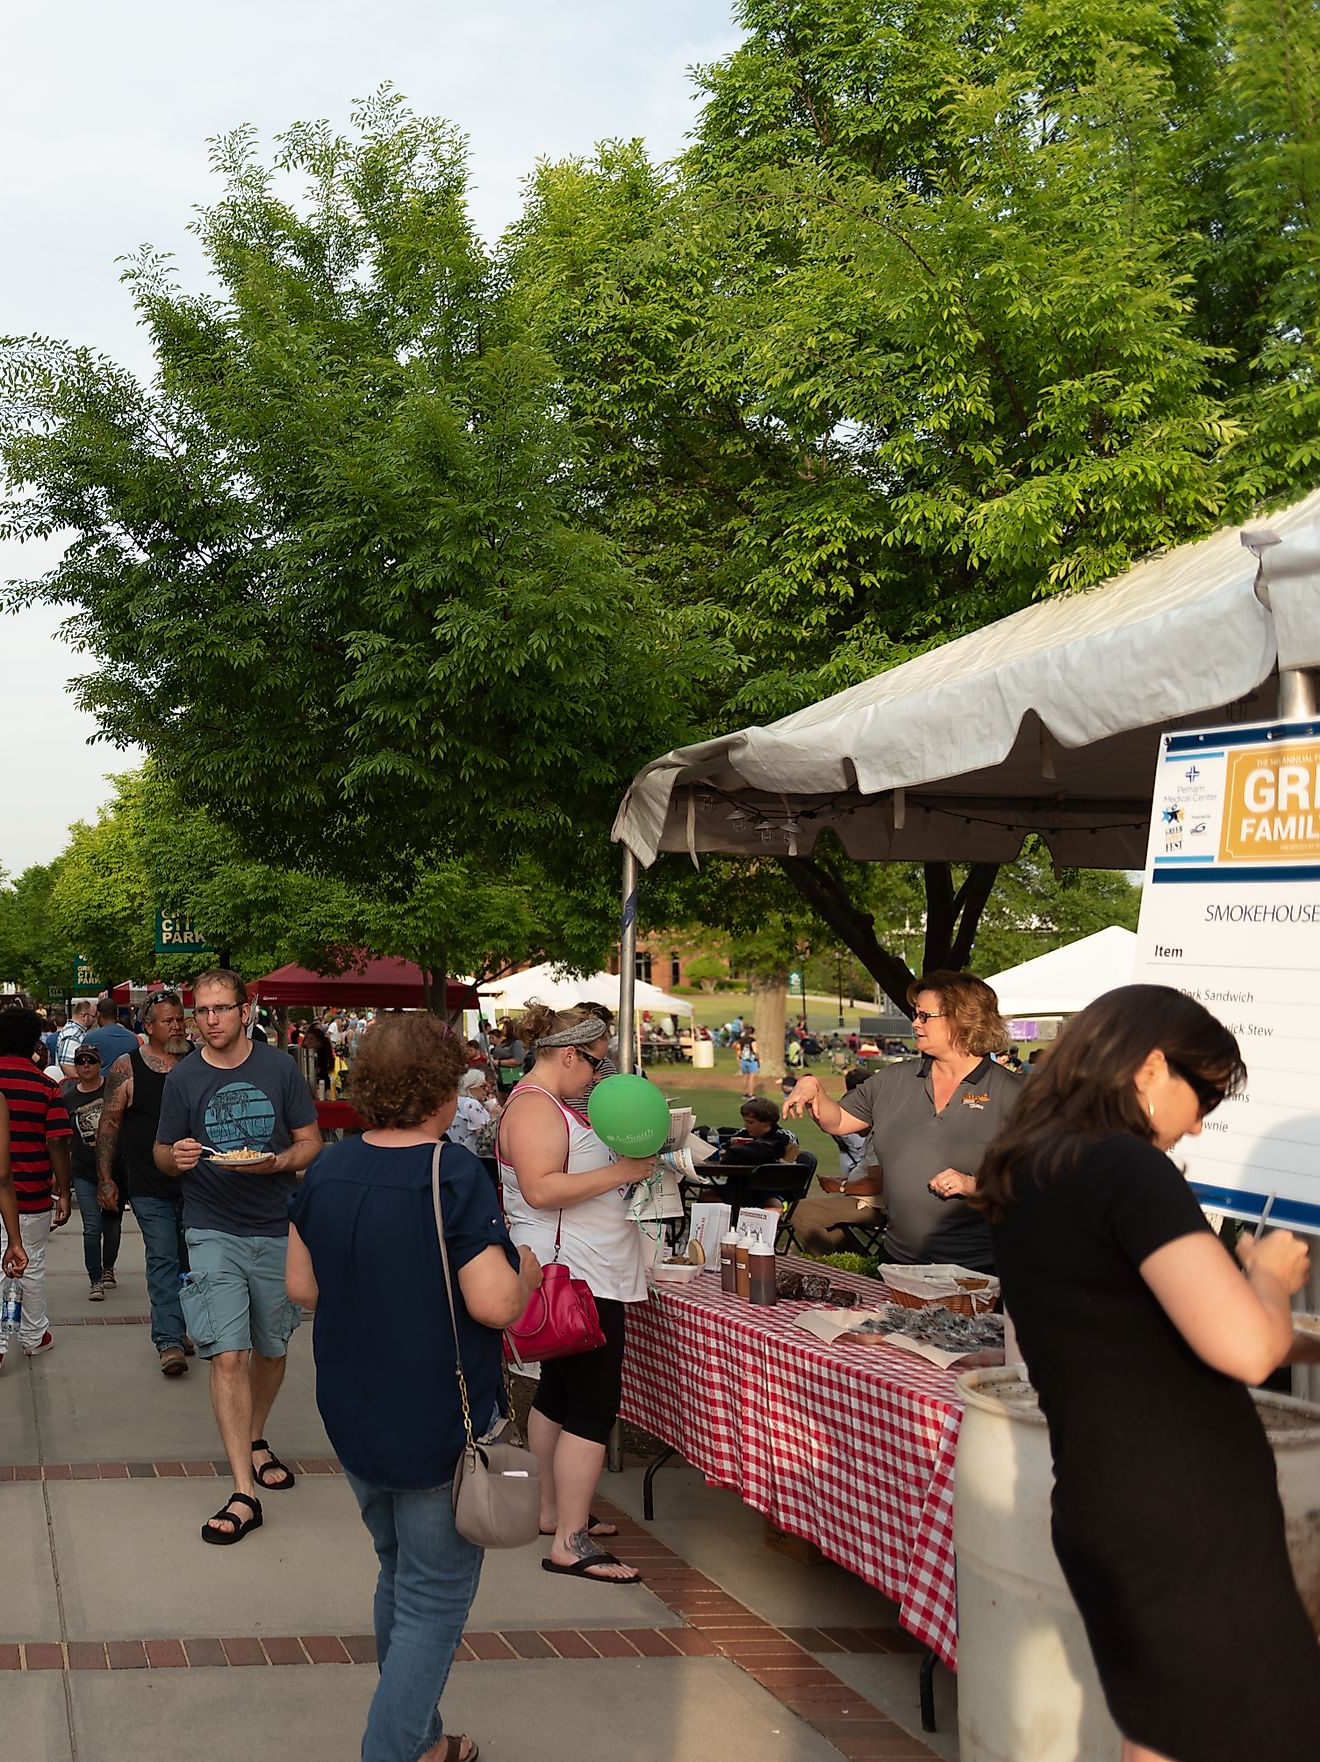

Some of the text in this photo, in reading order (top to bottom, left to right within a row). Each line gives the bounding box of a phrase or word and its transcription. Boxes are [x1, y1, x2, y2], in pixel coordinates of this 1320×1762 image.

[1282, 755, 1313, 764] ANNUAL
[1244, 765, 1320, 812] GR
[1240, 816, 1320, 842] FAMIL
[1205, 904, 1320, 923] SMOKEHOUSE
[162, 932, 206, 944] PARK
[1154, 945, 1183, 958] Item
[1204, 989, 1254, 1003] Sandwich
[1247, 1024, 1273, 1036] Stew
